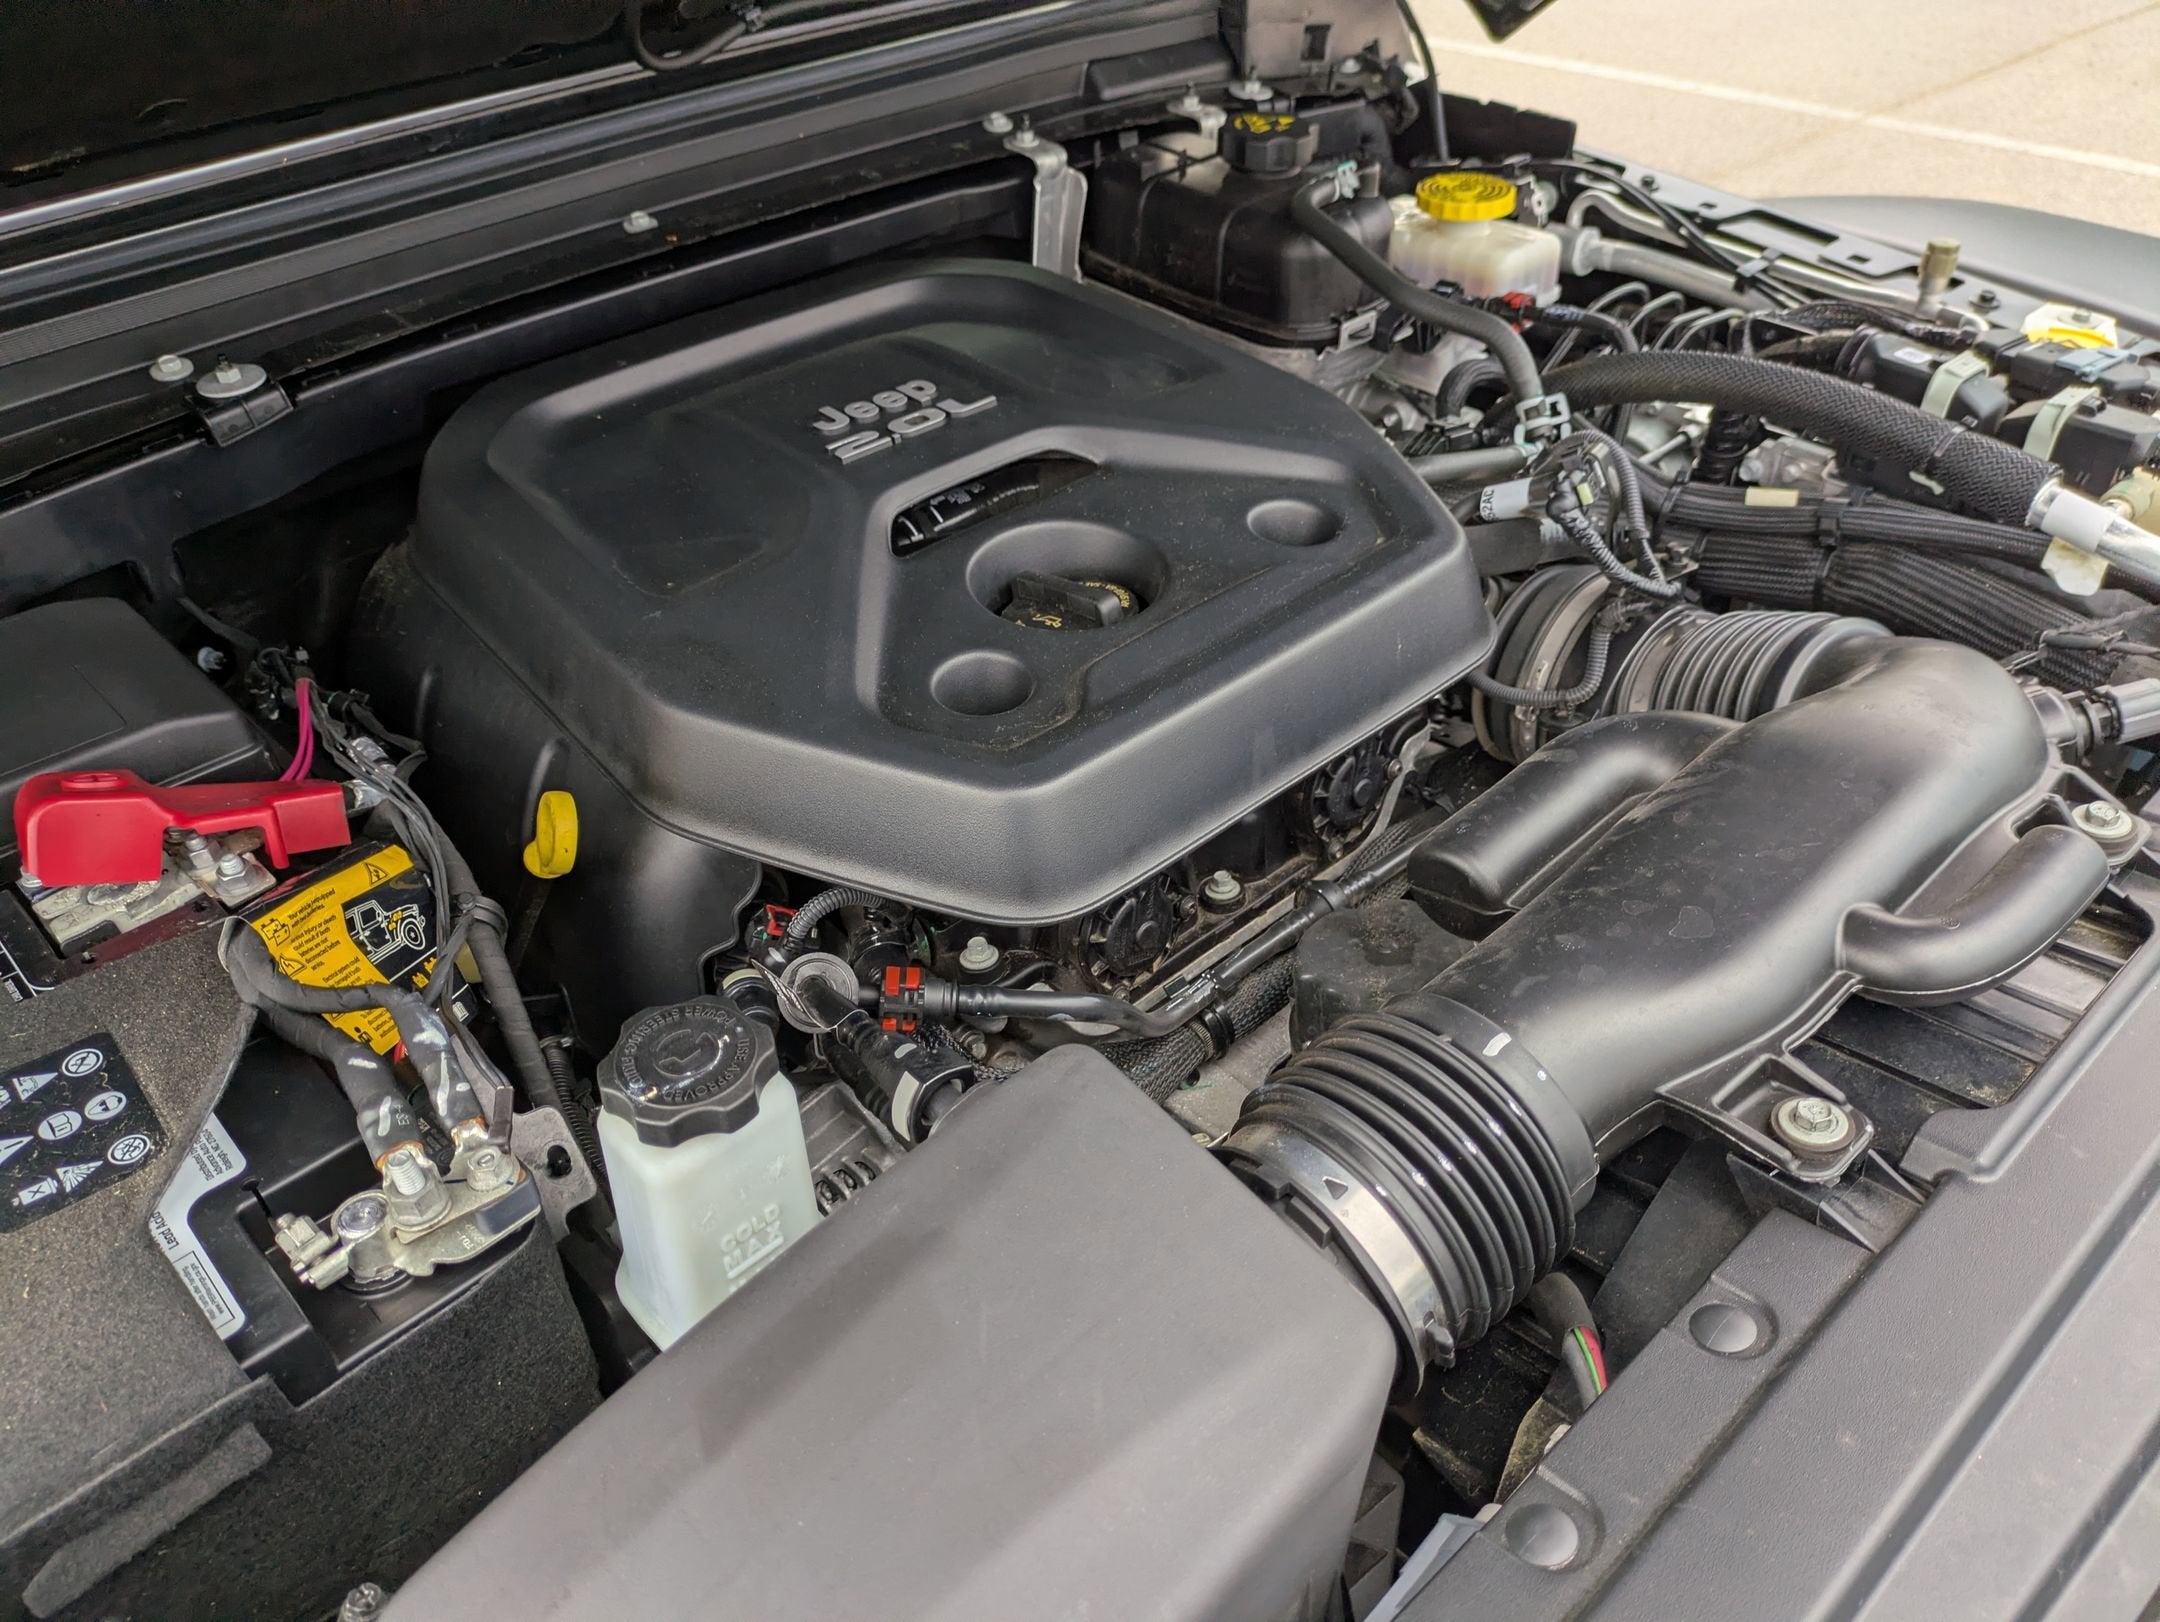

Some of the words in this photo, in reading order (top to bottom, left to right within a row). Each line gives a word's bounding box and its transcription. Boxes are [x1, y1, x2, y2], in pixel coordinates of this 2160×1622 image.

[812, 379, 938, 436] Jeep
[825, 395, 998, 465] 2.0L
[624, 1008, 681, 1055] STEERING
[684, 1006, 738, 1027] POWER
[733, 1038, 750, 1062] USE
[663, 1065, 741, 1101] APPROVED
[200, 1142, 211, 1155] Auto
[207, 1154, 223, 1175] Advance
[158, 1226, 180, 1251] Lead
[720, 1203, 780, 1253] COLD
[723, 1219, 783, 1275] MAX
